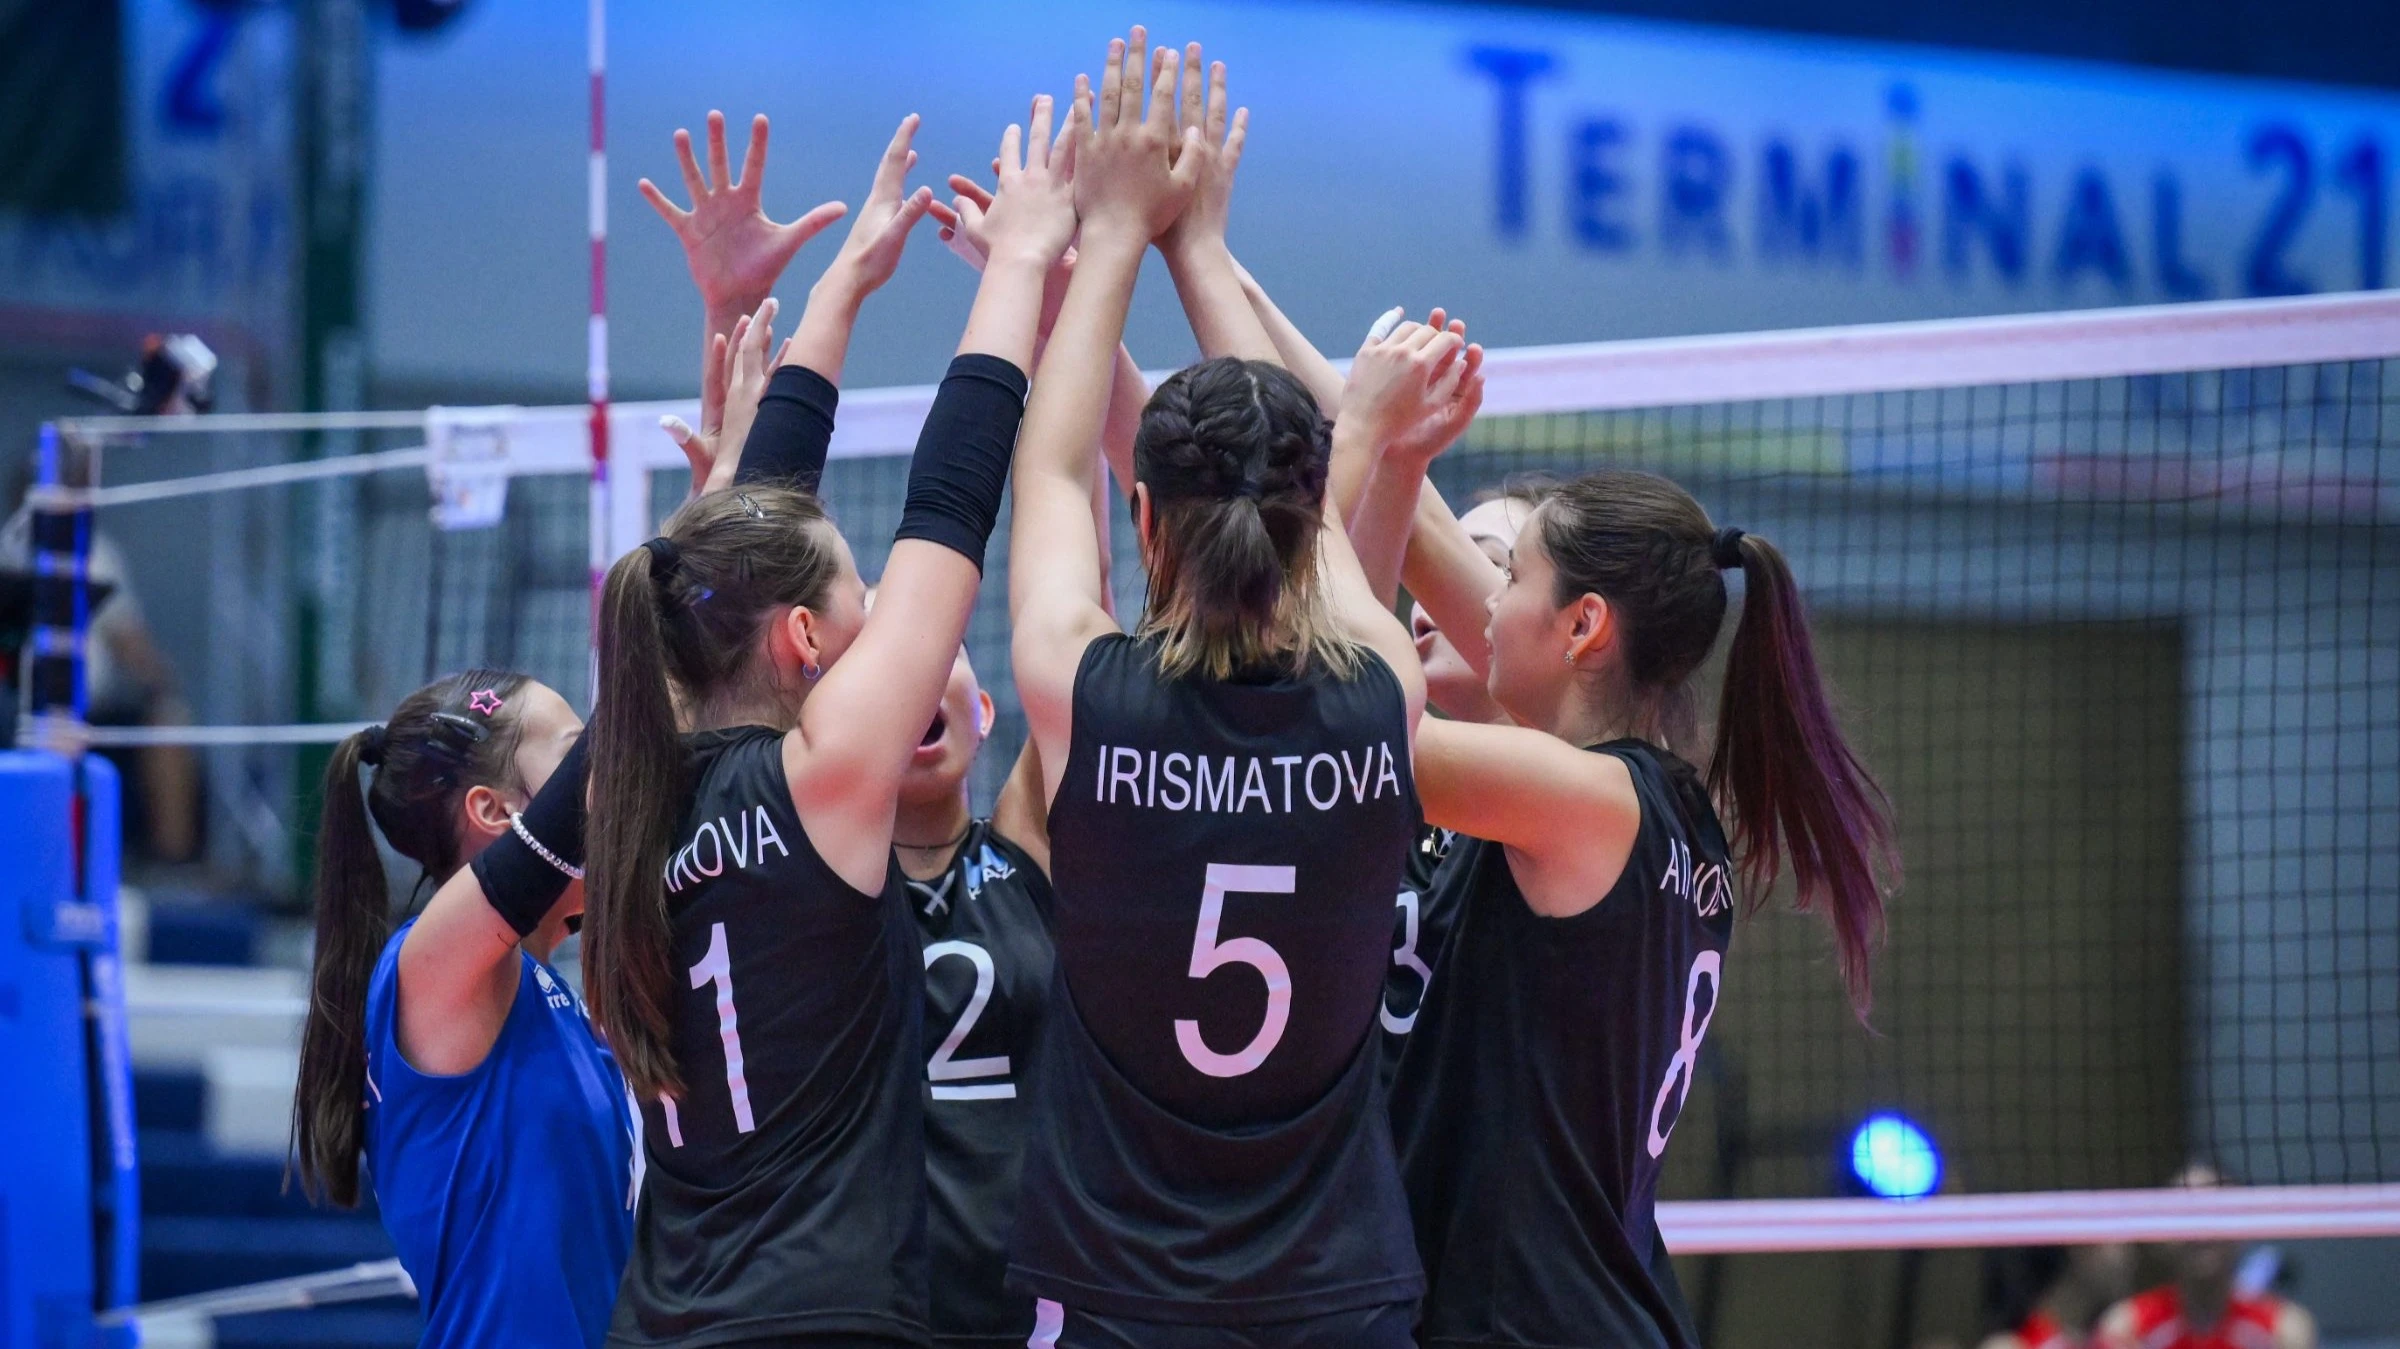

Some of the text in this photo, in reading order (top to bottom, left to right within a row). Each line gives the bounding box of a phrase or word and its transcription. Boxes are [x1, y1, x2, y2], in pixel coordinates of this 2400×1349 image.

[2244, 122, 2388, 297] 21
[1096, 742, 1400, 813] IRISMATOVA
[659, 922, 755, 1148] 1
[922, 940, 1011, 1081] 2
[1174, 862, 1297, 1078] 5
[1379, 890, 1432, 1034] 3
[1647, 949, 1721, 1159] 8
